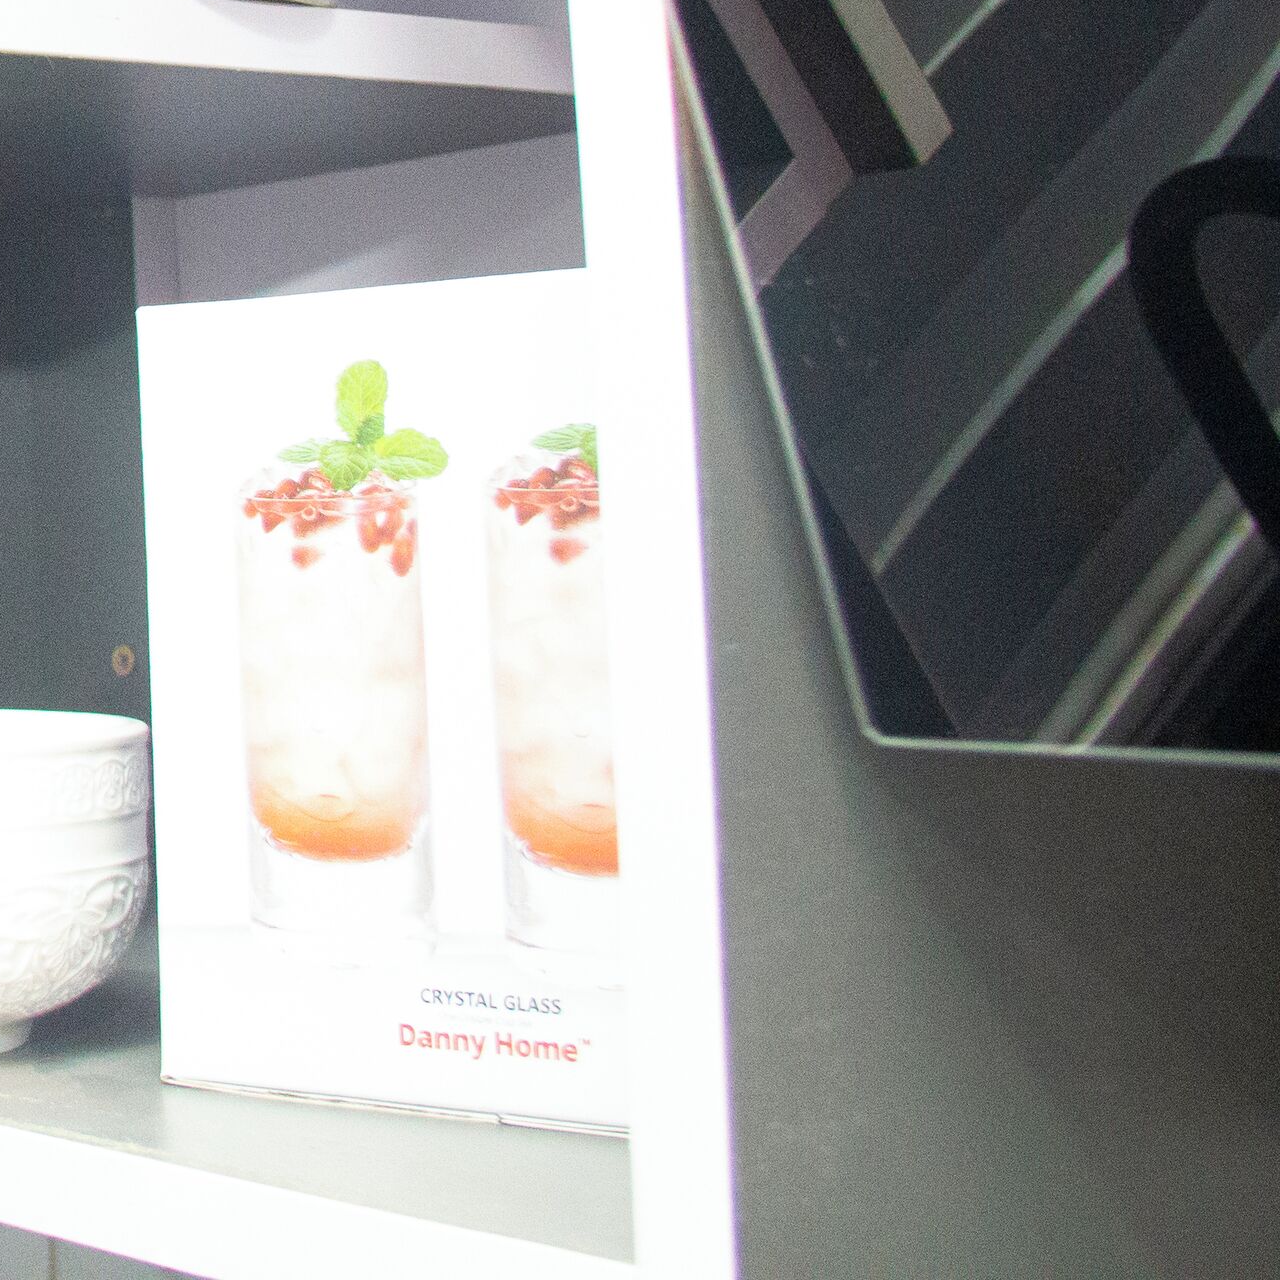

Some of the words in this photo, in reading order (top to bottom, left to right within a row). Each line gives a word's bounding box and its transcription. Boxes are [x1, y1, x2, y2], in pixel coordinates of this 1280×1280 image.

[420, 988, 498, 1010] CRYSTAL
[503, 995, 562, 1015] GLASS
[399, 1023, 486, 1060] Danny
